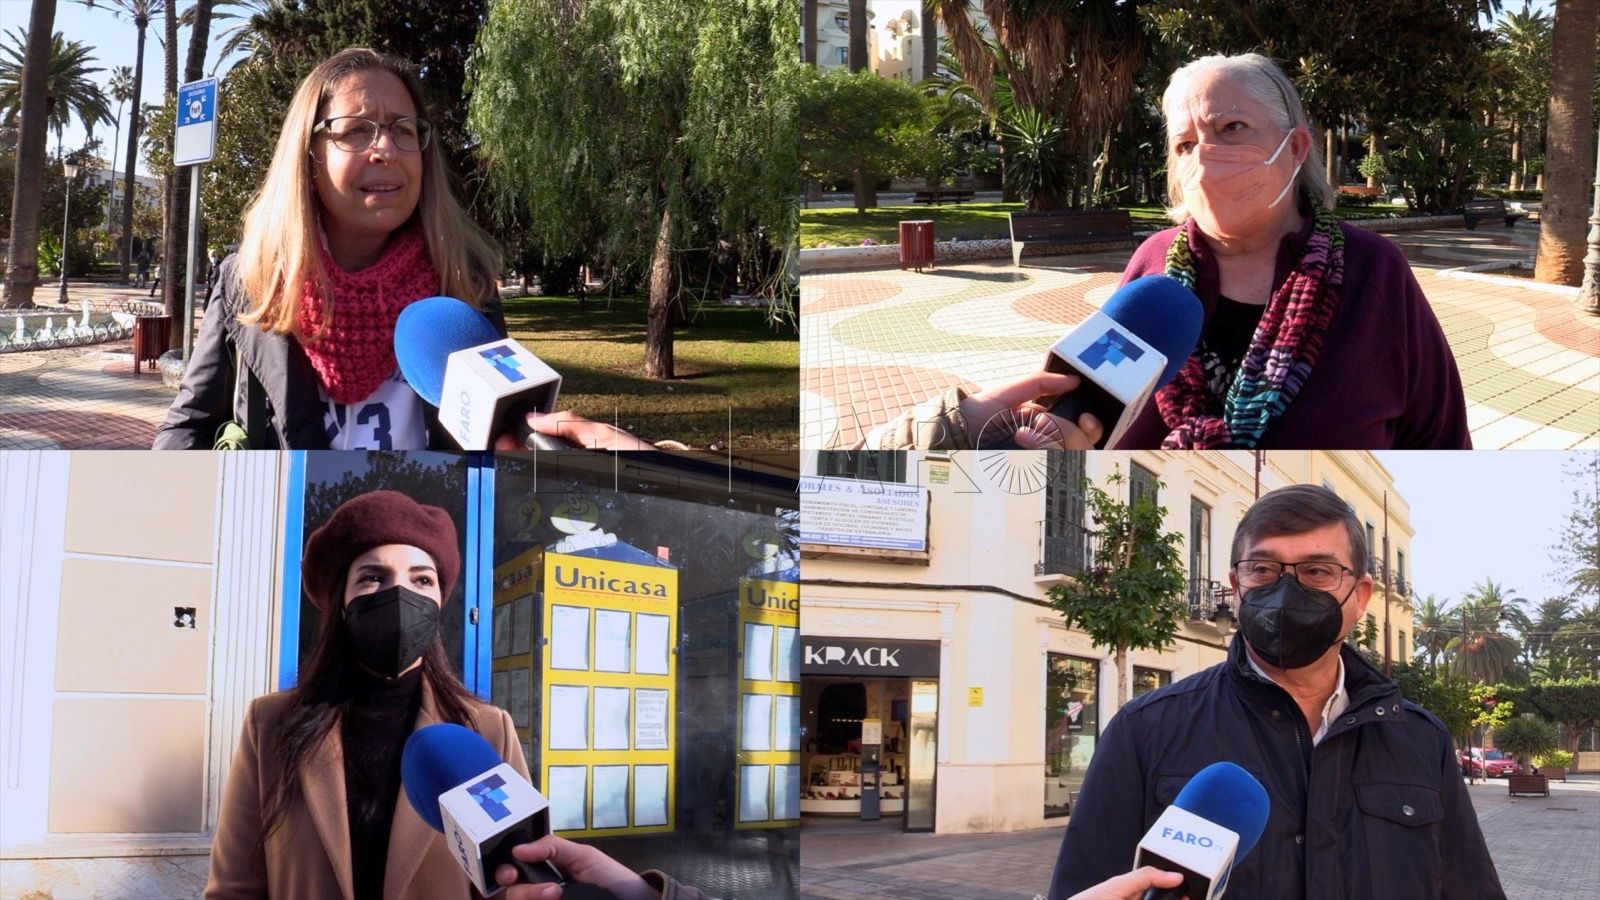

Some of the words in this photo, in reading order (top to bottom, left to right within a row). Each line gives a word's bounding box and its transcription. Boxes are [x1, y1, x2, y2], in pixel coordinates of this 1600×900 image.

[460, 390, 471, 443] FARO
[876, 498, 920, 507] ASESORES
[554, 566, 668, 597] Unicasa
[804, 645, 900, 667] KRACK
[1162, 827, 1213, 848] FARO
